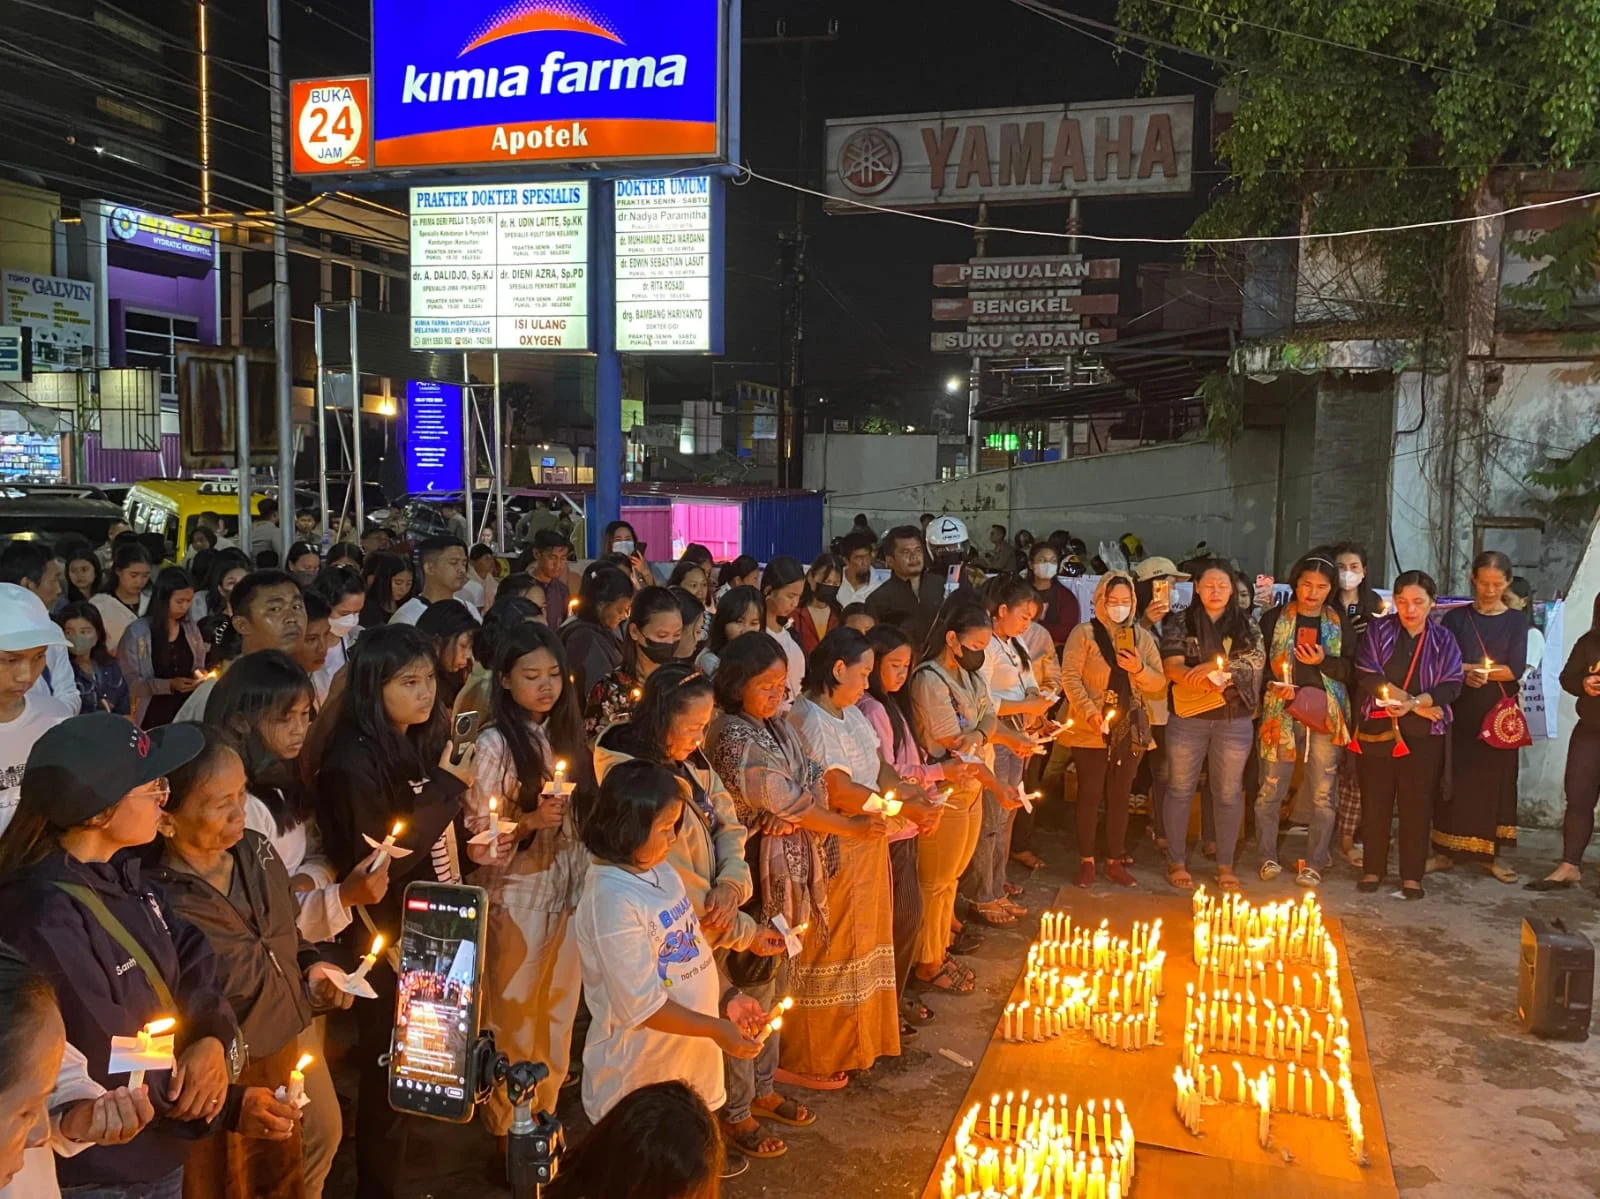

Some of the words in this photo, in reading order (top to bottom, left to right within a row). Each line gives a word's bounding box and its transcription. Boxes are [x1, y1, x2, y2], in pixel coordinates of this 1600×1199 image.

[540, 50, 687, 94] farma
[312, 88, 352, 104] BUKA
[309, 106, 354, 143] 24
[491, 122, 588, 154] Apotek
[318, 147, 342, 158] JAM
[921, 113, 1178, 189] YAMAHA
[617, 180, 666, 196] DOKTER
[670, 176, 707, 194] UMUM
[417, 192, 468, 208] PRAKTEK
[472, 190, 518, 206] DOKTER
[522, 187, 580, 204] SPESIALIS
[518, 217, 534, 228] UDIN
[660, 210, 706, 220] Paramitha
[959, 262, 1090, 280] PENJUALAN
[8, 274, 30, 283] TOKO
[32, 278, 92, 301] GALVIN
[972, 298, 1072, 314] BENGKEL
[515, 320, 528, 329] ISI
[531, 320, 566, 329] ULANG
[520, 336, 561, 346] OXYGEN
[945, 332, 1002, 348] SUKU
[1011, 331, 1101, 347] CADANG
